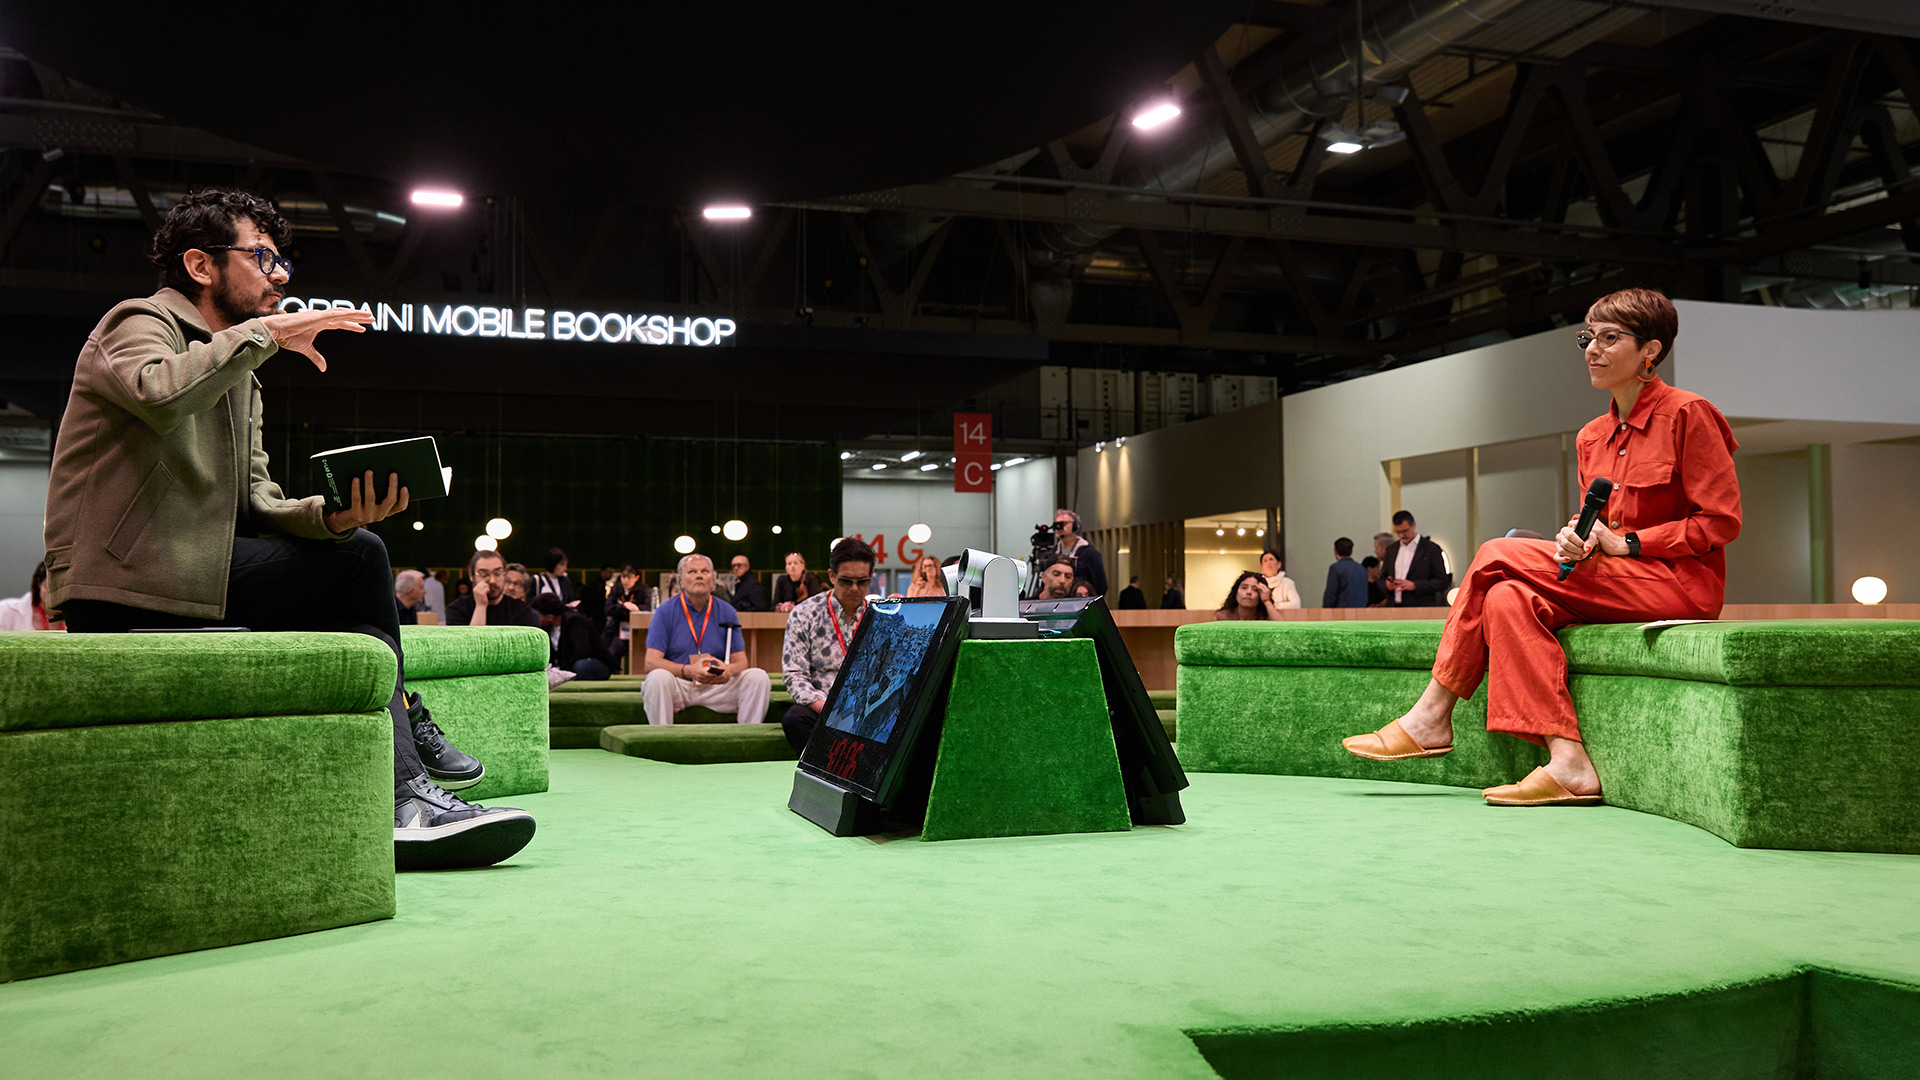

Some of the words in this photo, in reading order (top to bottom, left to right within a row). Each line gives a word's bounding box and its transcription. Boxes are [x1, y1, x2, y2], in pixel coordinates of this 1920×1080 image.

[422, 304, 546, 339] MOBILE
[553, 311, 737, 346] BOOKSHOP
[959, 421, 987, 445] 14
[964, 462, 983, 486] C
[855, 533, 888, 564] 4
[897, 533, 924, 565] G
